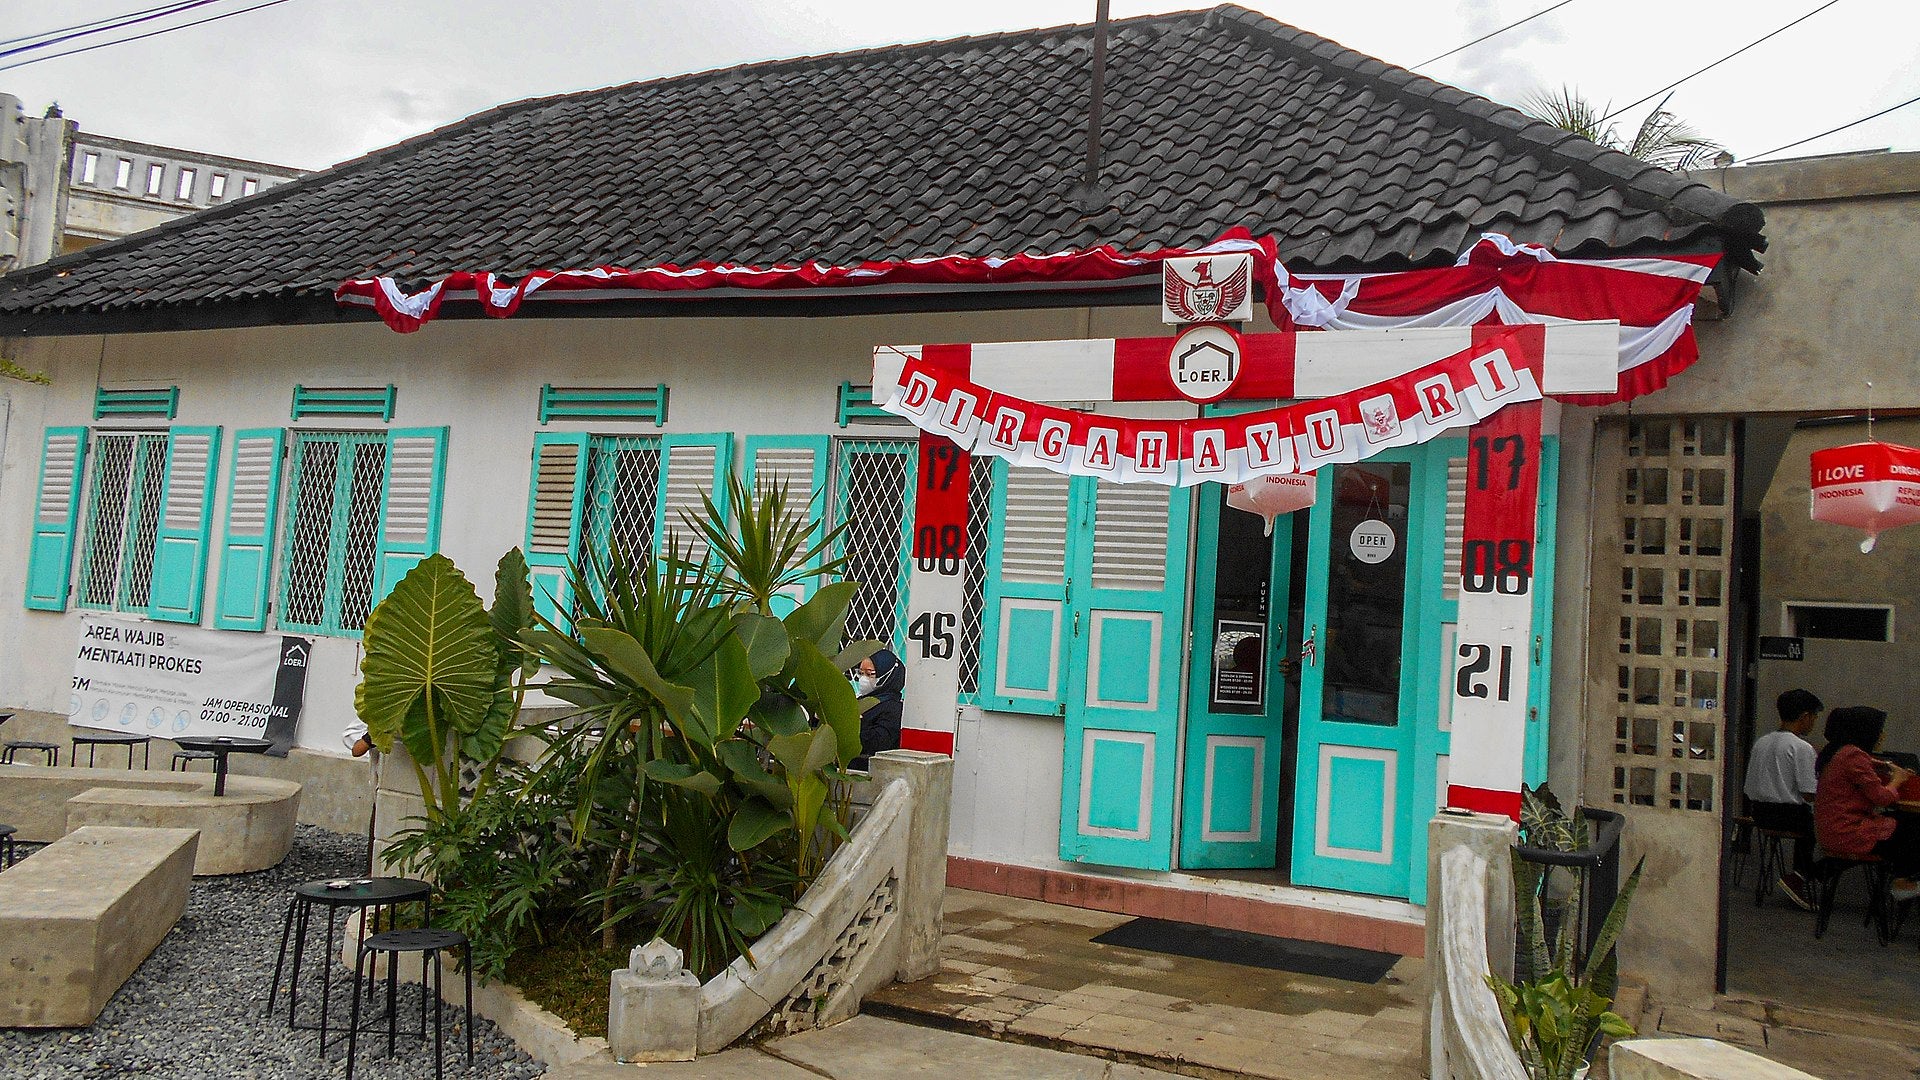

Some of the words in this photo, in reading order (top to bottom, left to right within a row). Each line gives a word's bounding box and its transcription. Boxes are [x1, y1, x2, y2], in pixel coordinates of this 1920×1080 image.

[905, 371, 1336, 469] DIRGAHAYU
[1422, 359, 1507, 419] RI
[925, 444, 960, 491] 17
[1472, 434, 1527, 491] 17
[1825, 464, 1864, 481] LOVE
[1265, 476, 1307, 487] INDONESIA
[1819, 488, 1864, 500] INDONESIA
[917, 524, 961, 576] 08
[1359, 535, 1386, 546] OPEN
[1462, 539, 1532, 596] 08
[85, 625, 120, 642] AREA
[124, 629, 165, 647] WAJIB
[908, 612, 956, 661] 45
[78, 645, 146, 668] MENTAATI
[149, 654, 202, 675] PROKES
[1455, 642, 1513, 702] 21
[200, 710, 230, 723] 07.00
[237, 715, 267, 728] 21.00
[202, 697, 223, 708] JAM
[223, 700, 289, 718] OPERASIONAL
